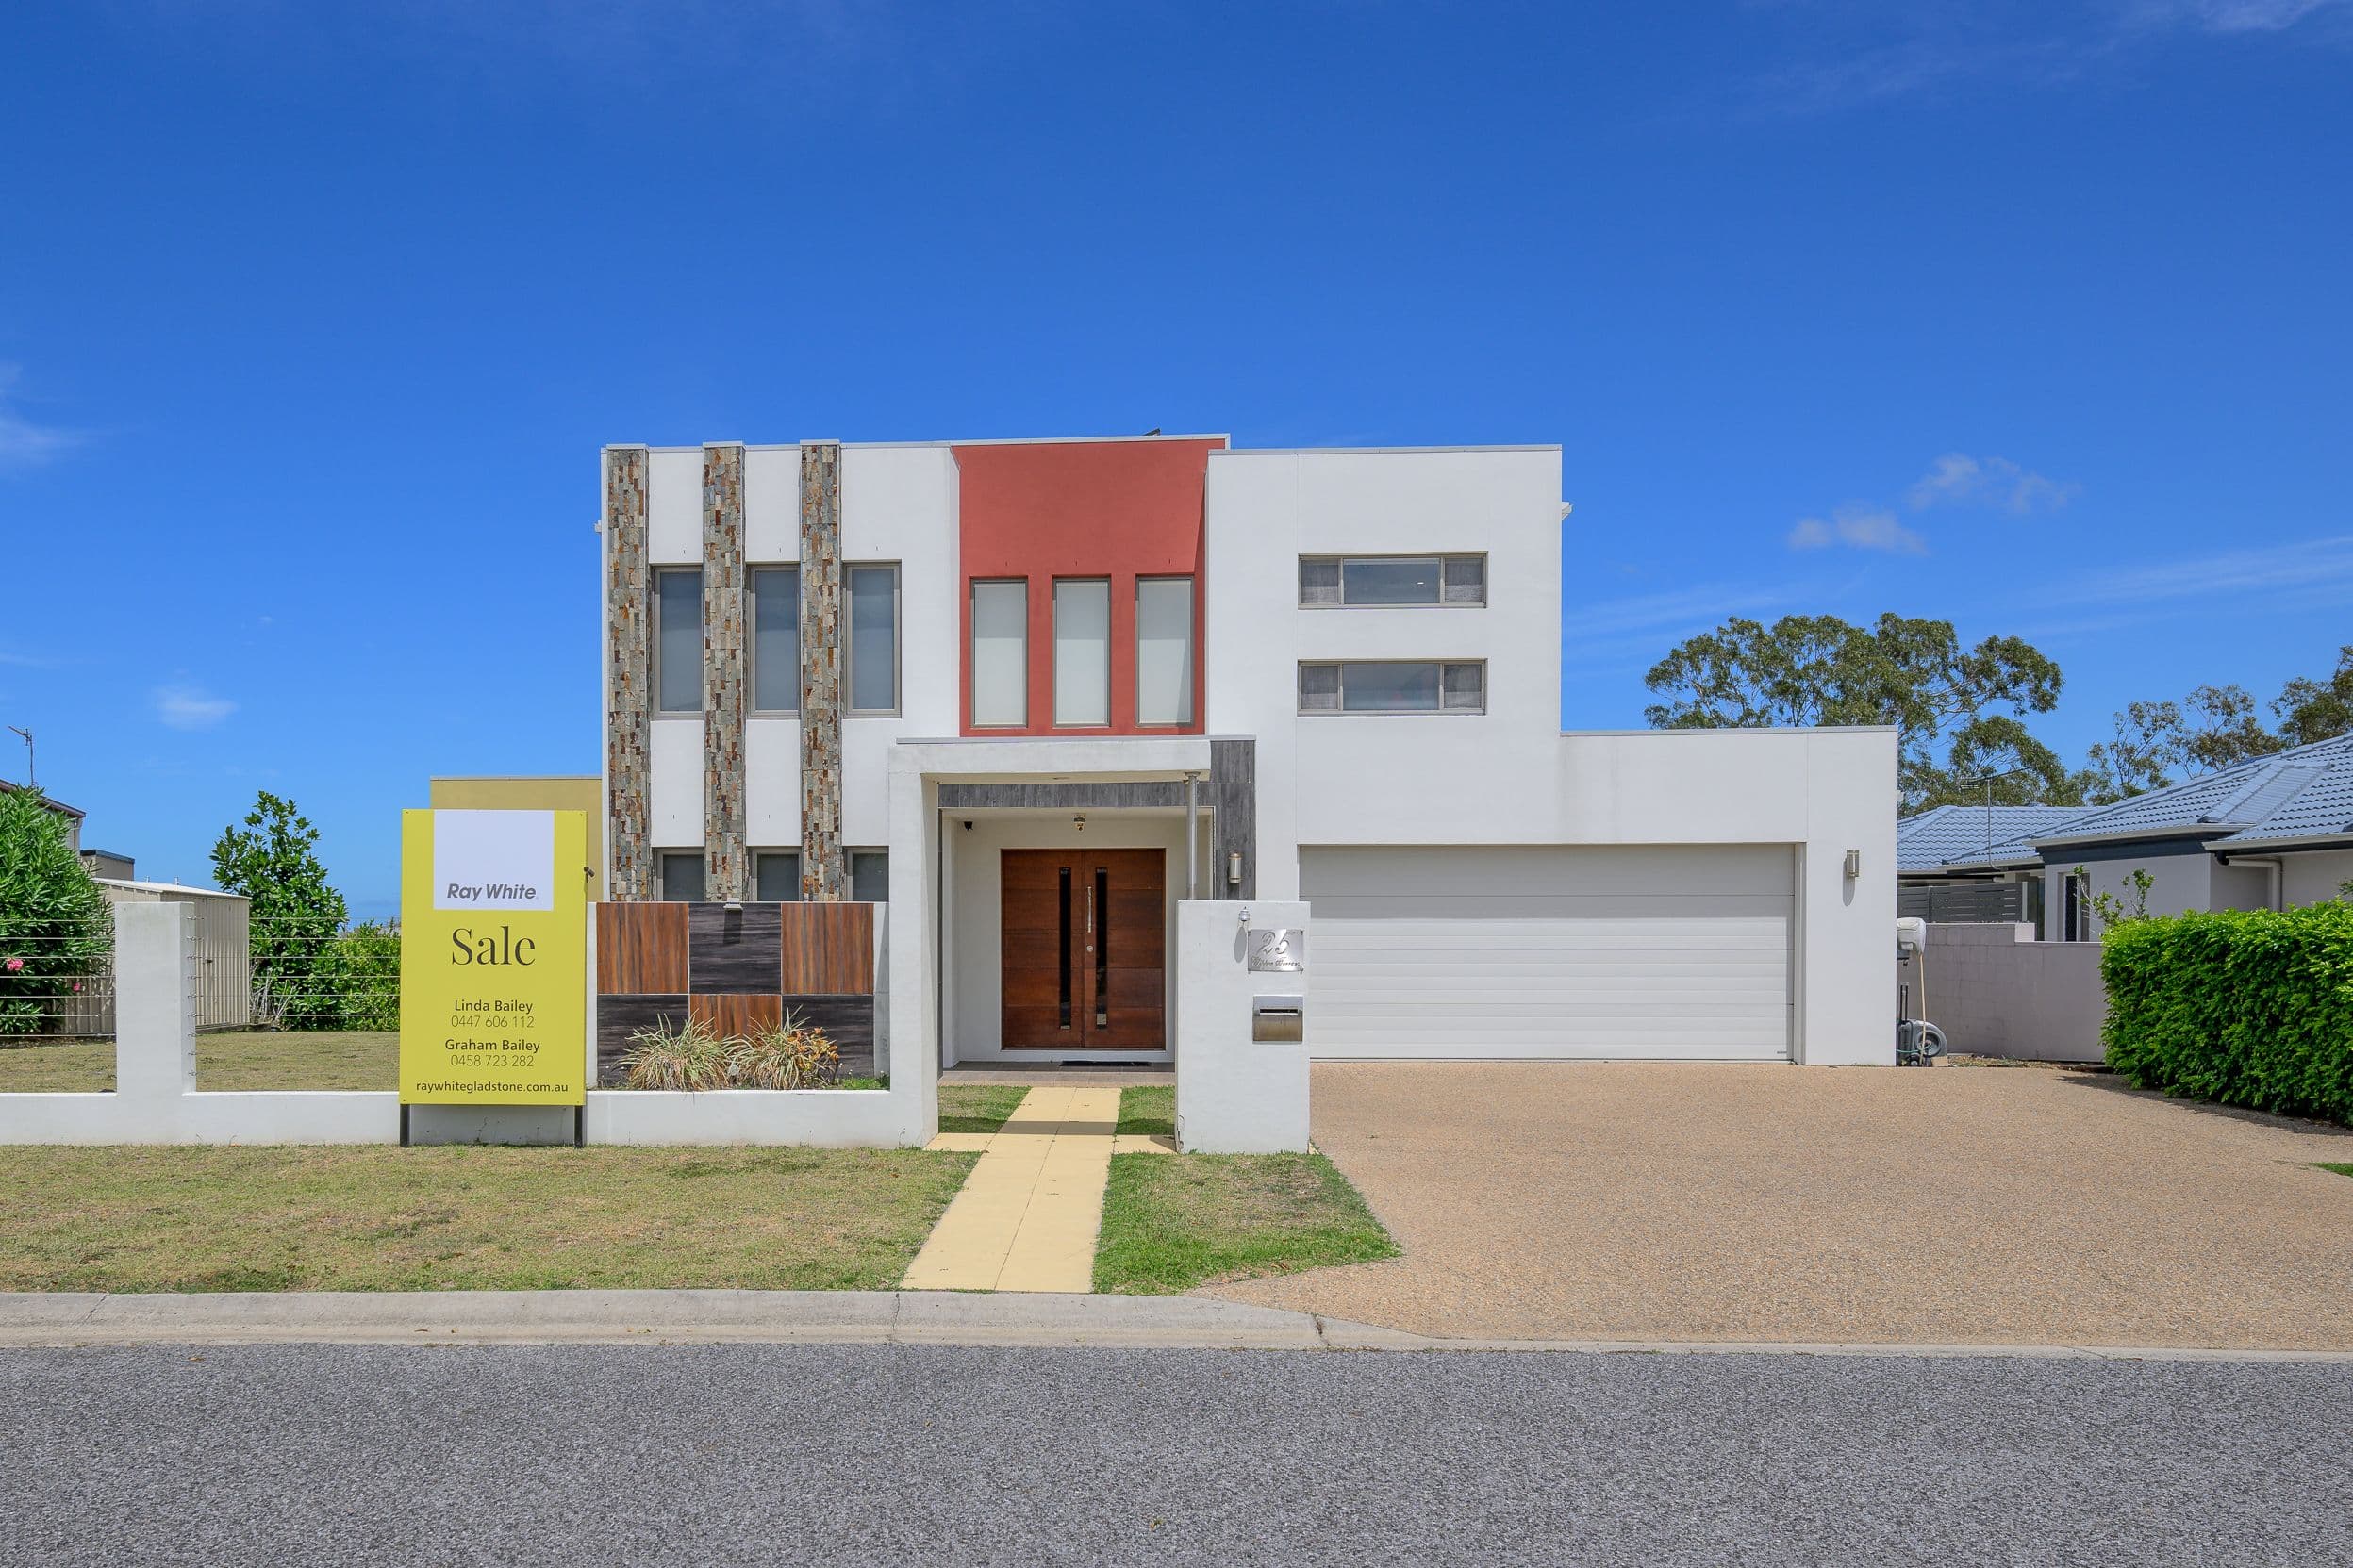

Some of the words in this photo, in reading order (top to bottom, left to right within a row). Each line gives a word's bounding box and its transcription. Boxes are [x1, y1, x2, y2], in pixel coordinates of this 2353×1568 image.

[447, 883, 483, 901] Ray
[486, 883, 538, 900] White
[452, 925, 537, 966] Sale
[454, 999, 490, 1012] Linda
[494, 999, 533, 1015] Bailey
[451, 1015, 481, 1028] 0447
[485, 1015, 508, 1028] 606
[513, 1015, 535, 1028] 112
[445, 1039, 498, 1051] Graham
[502, 1039, 540, 1054] Bailey
[450, 1054, 482, 1067] 0458
[485, 1054, 508, 1067] 723
[511, 1055, 534, 1068] 282
[416, 1081, 569, 1095] raywhitegladstone.com.au
